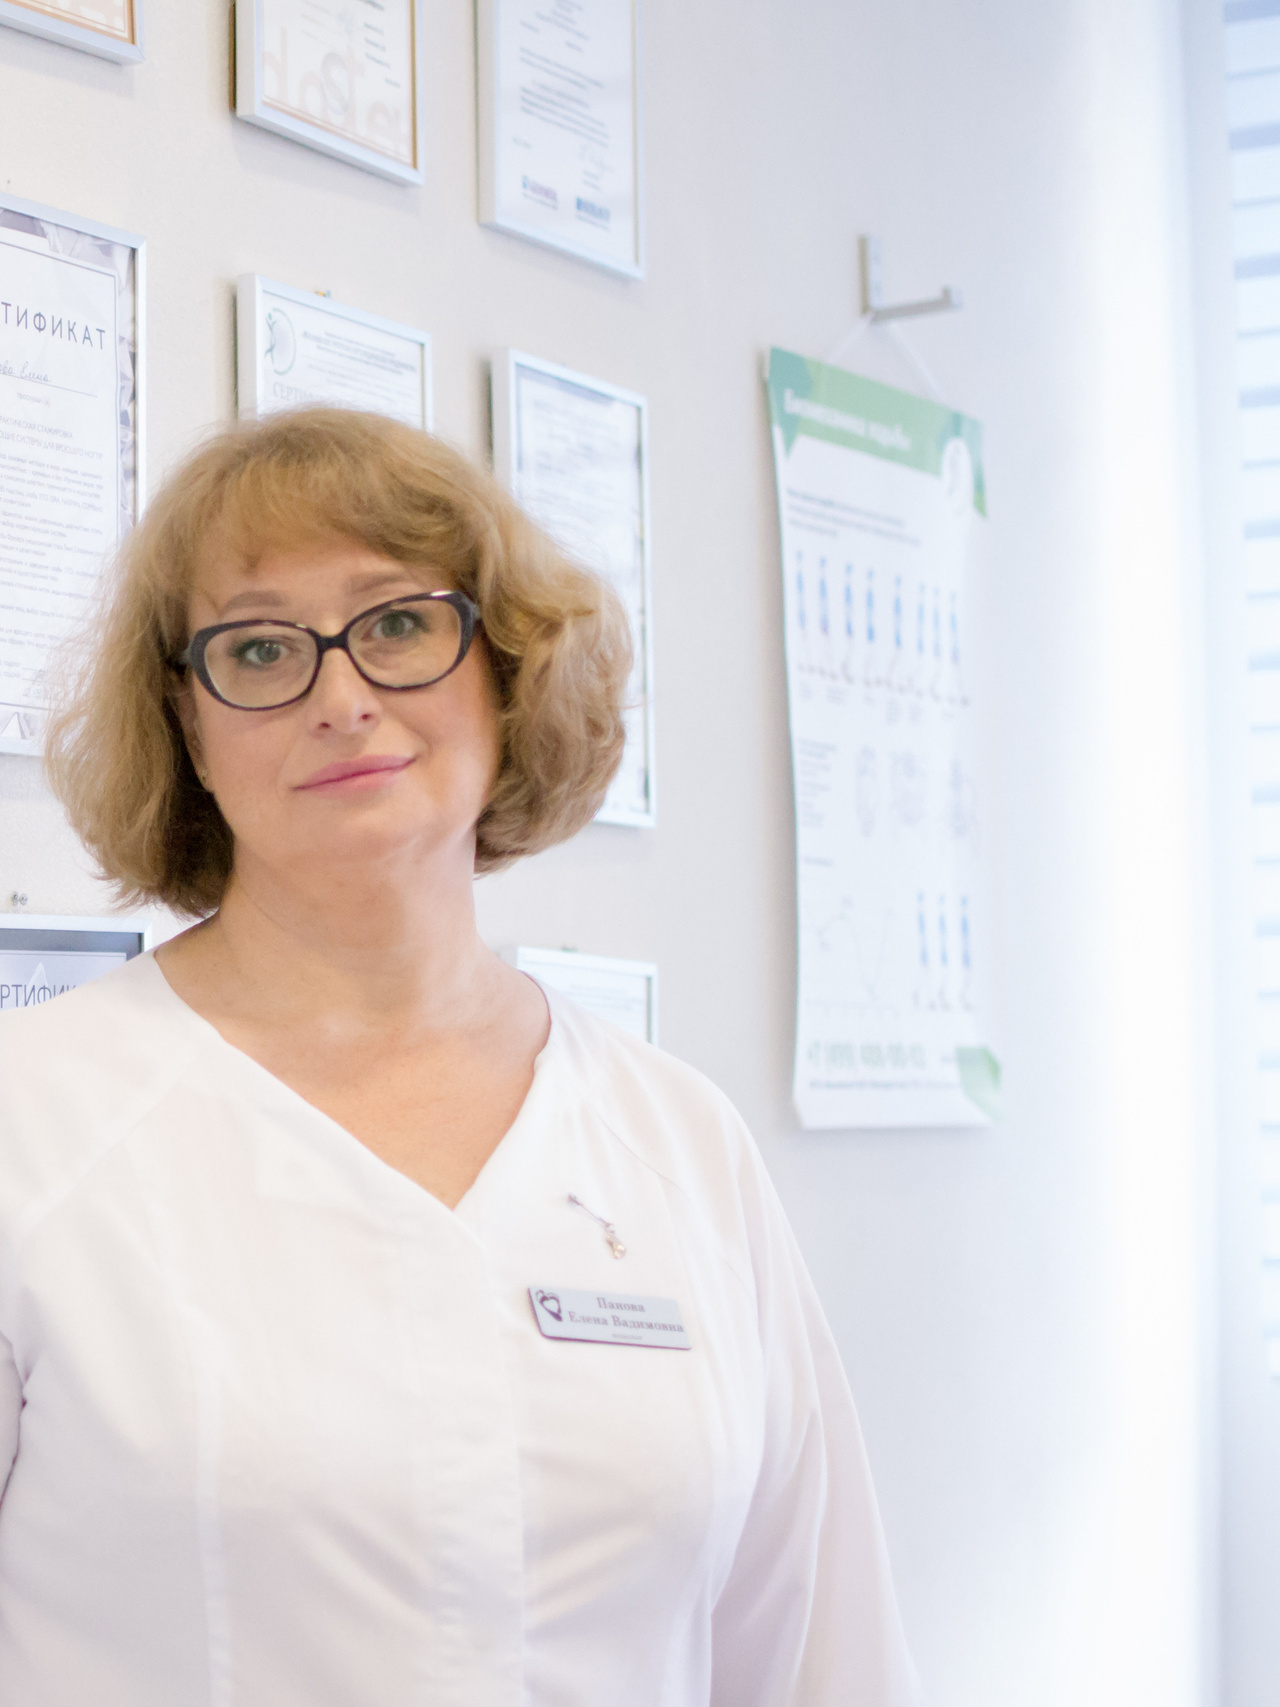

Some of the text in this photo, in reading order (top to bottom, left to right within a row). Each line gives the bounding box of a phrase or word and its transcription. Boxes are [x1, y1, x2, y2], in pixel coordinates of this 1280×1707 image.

[596, 1297, 646, 1313] Панова
[568, 1311, 685, 1333] Елена Вадимовна
